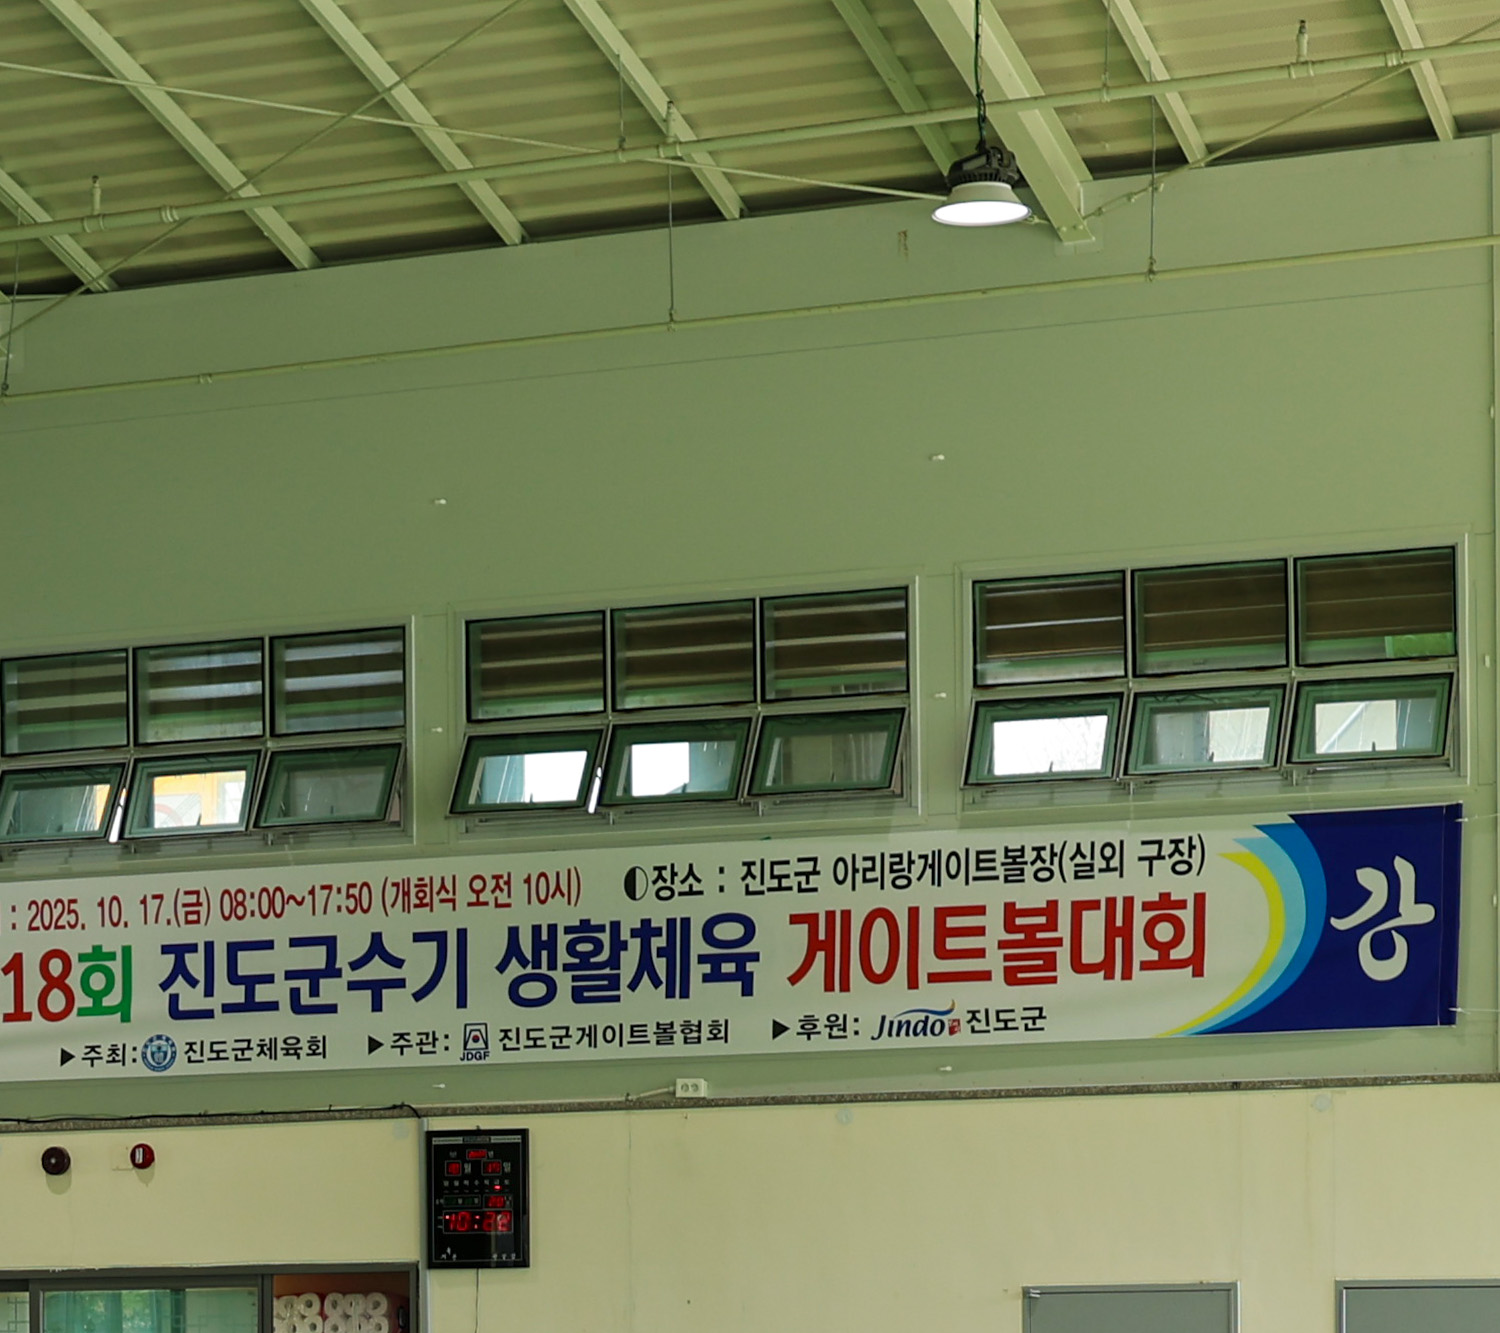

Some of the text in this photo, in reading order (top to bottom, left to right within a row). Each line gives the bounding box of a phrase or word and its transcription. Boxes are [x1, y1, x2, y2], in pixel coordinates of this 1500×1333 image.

[27, 899, 86, 932] 2025.
[97, 894, 129, 929] 10.
[139, 886, 212, 927] 17.(금)
[219, 880, 373, 922] 08:00~17:50
[381, 873, 458, 917] (개회식
[466, 871, 513, 910] 오전
[523, 866, 581, 907] 10시)
[651, 862, 704, 902] 장소
[740, 856, 822, 897] 진도군
[832, 838, 1126, 894] 아리랑게이트볼장(실외
[1137, 834, 1207, 878] 구장)
[1329, 855, 1436, 982] 강
[158, 927, 469, 1022] 진도군수기
[495, 912, 761, 1008] 생활체육
[786, 892, 1207, 994] 게이트볼대회
[81, 1042, 138, 1068] 주최:
[183, 1034, 328, 1065] 진도군체육회
[390, 1018, 731, 1062] 주관: JDGF 진도군게이트볼협회
[796, 1006, 1047, 1041] 후원: Jindo 진도군
